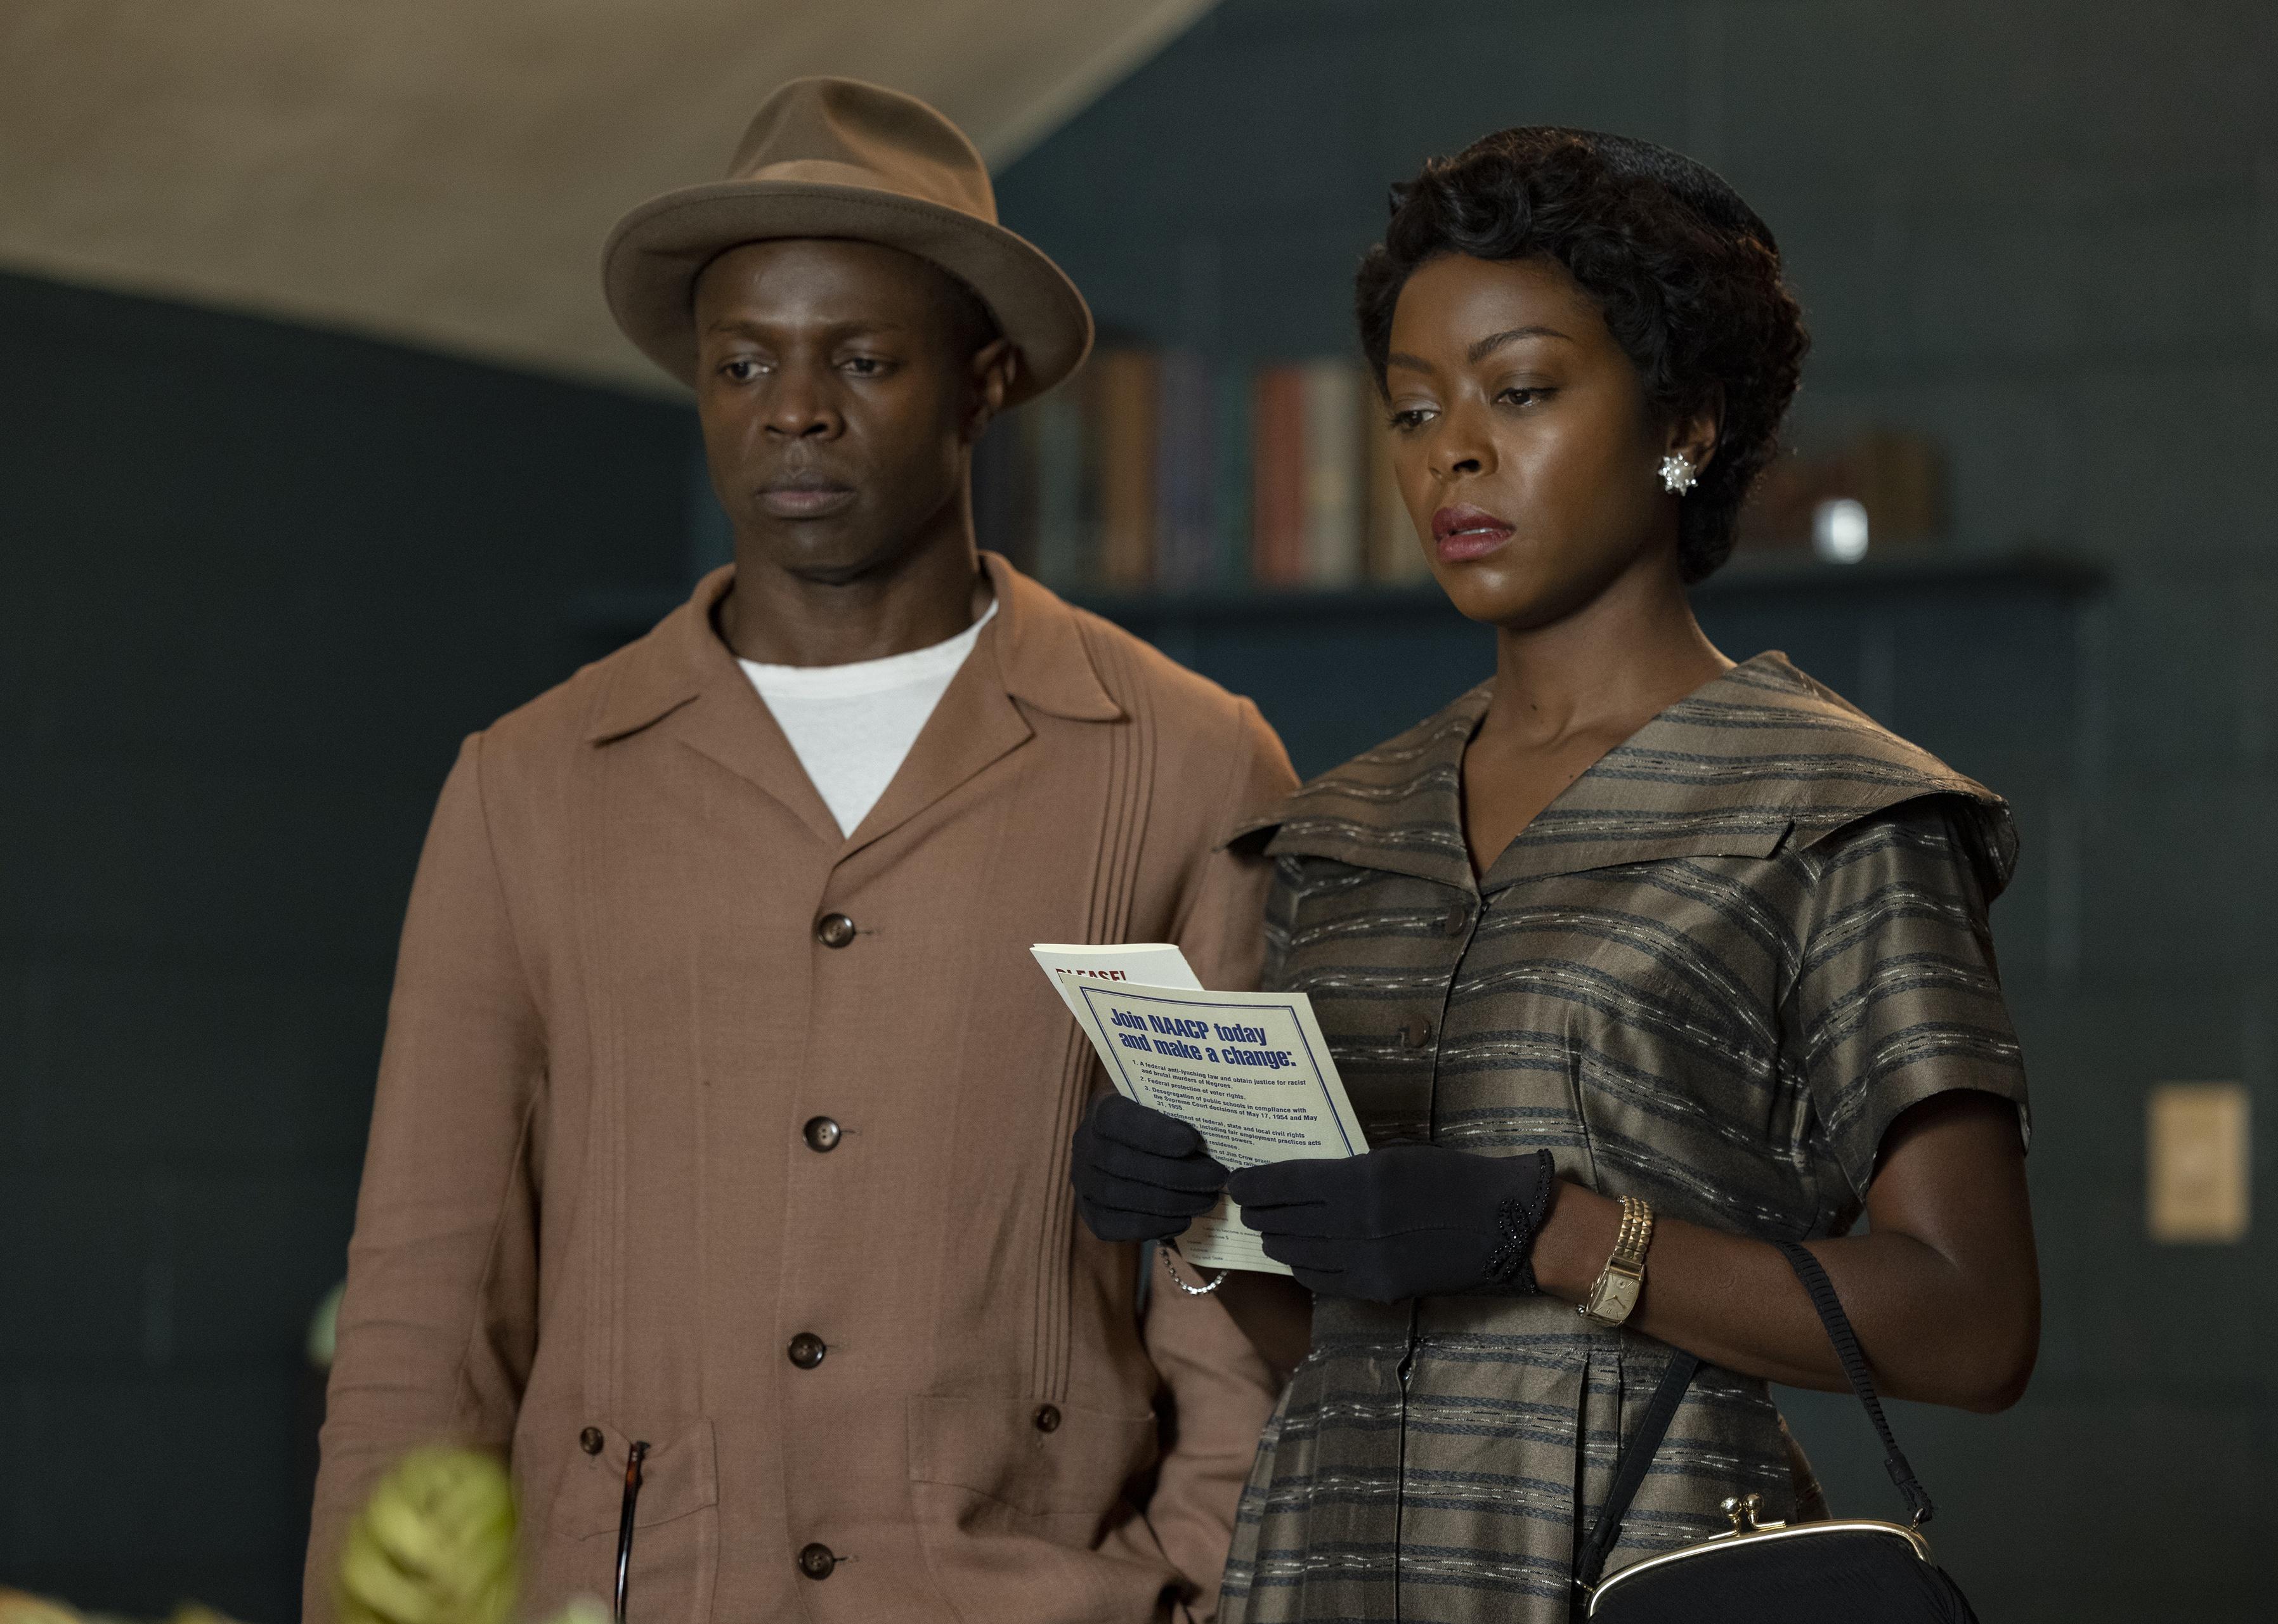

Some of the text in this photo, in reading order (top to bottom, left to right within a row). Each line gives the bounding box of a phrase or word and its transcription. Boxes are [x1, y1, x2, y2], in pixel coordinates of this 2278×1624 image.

[1110, 1008, 1267, 1046] Join NAACP today
[1118, 1033, 1297, 1070] and make a change:
[1145, 1062, 1166, 1071] federal
[1168, 1067, 1206, 1079] anti-lynching
[1147, 1078, 1169, 1086] Federal
[1171, 1082, 1201, 1093] protection
[1173, 1075, 1197, 1083] murders
[1206, 1080, 1233, 1089] Negroes.
[1152, 1088, 1194, 1100] Desegregation
[1203, 1097, 1221, 1105] public
[1254, 1105, 1291, 1115] compliance
[1164, 1096, 1190, 1106] Supreme
[1209, 1105, 1237, 1114] decisions
[1162, 1110, 1194, 1121] Enactment
[1200, 1124, 1227, 1134] including
[1240, 1131, 1279, 1143] employment
[1209, 1141, 1240, 1150] residence.
[1215, 1155, 1242, 1165] including
